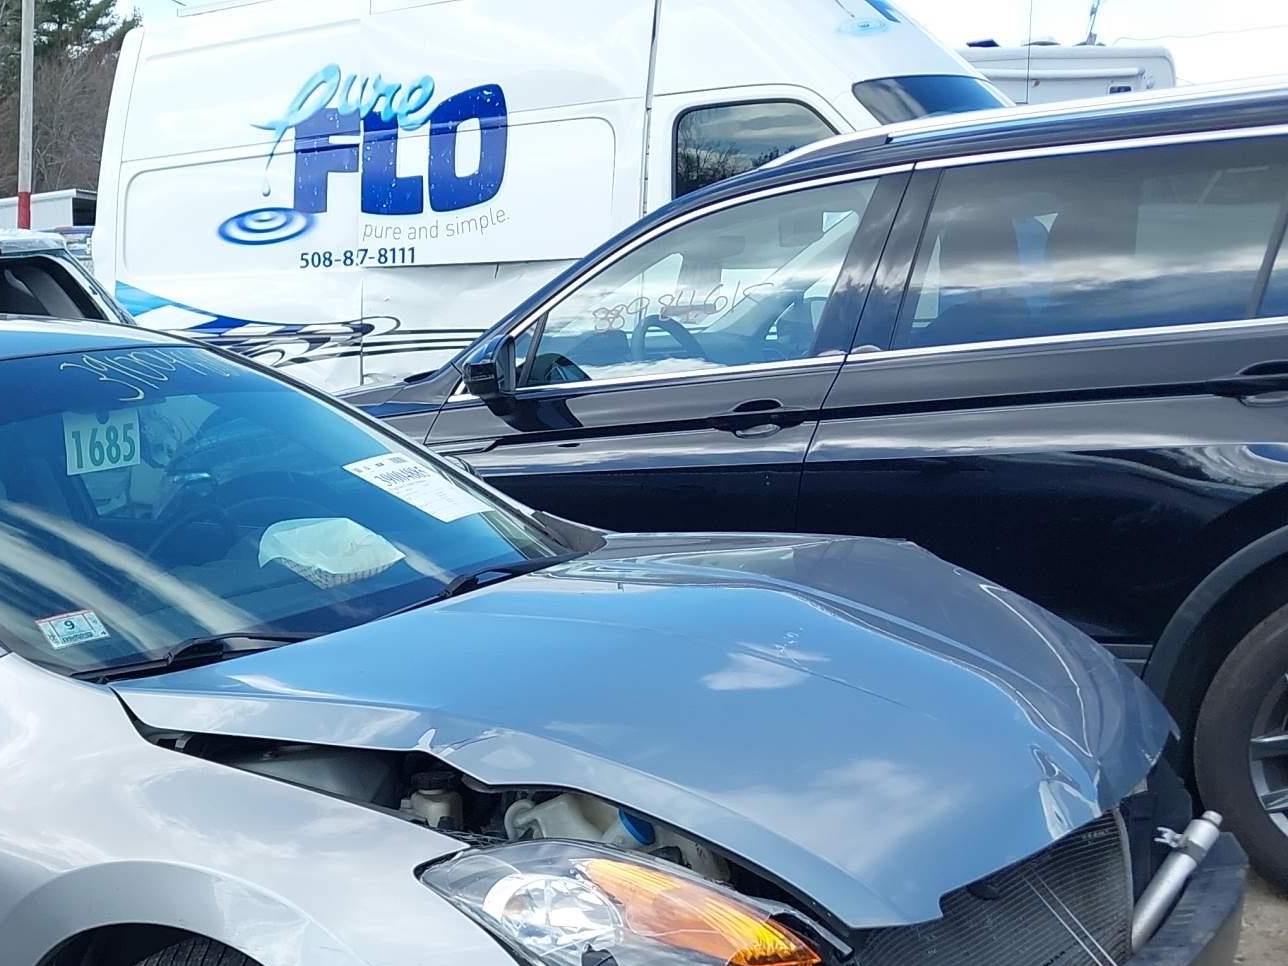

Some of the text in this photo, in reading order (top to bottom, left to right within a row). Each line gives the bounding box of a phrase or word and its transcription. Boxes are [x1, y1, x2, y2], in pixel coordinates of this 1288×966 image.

[293, 83, 508, 215] FLO
[362, 207, 510, 241] pure and simple.
[299, 246, 416, 269] 508-87-8111
[59, 349, 232, 401] 39004
[71, 422, 136, 470] 1685
